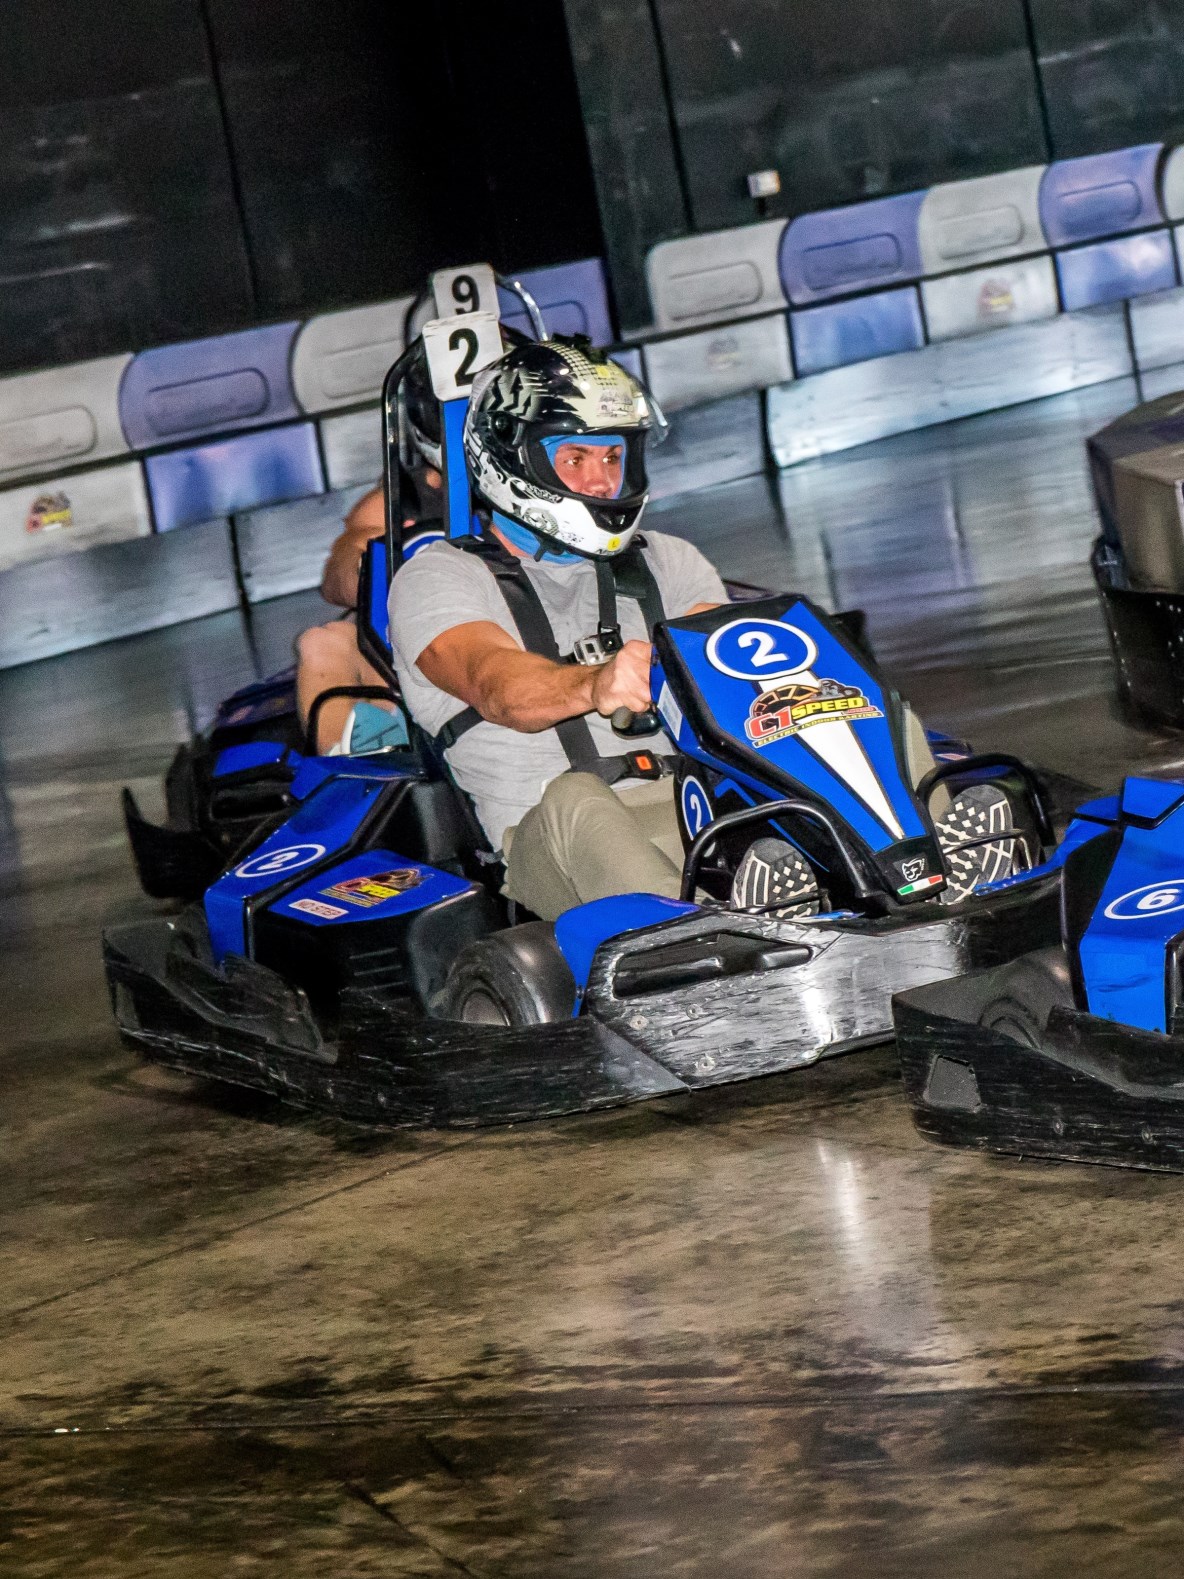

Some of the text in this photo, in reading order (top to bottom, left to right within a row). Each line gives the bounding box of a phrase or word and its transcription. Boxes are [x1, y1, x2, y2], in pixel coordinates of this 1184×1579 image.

[451, 274, 480, 315] 9
[448, 327, 480, 387] 2
[737, 630, 790, 668] 2
[690, 793, 703, 832] 2
[256, 851, 300, 871] 2
[1136, 888, 1180, 910] 6
